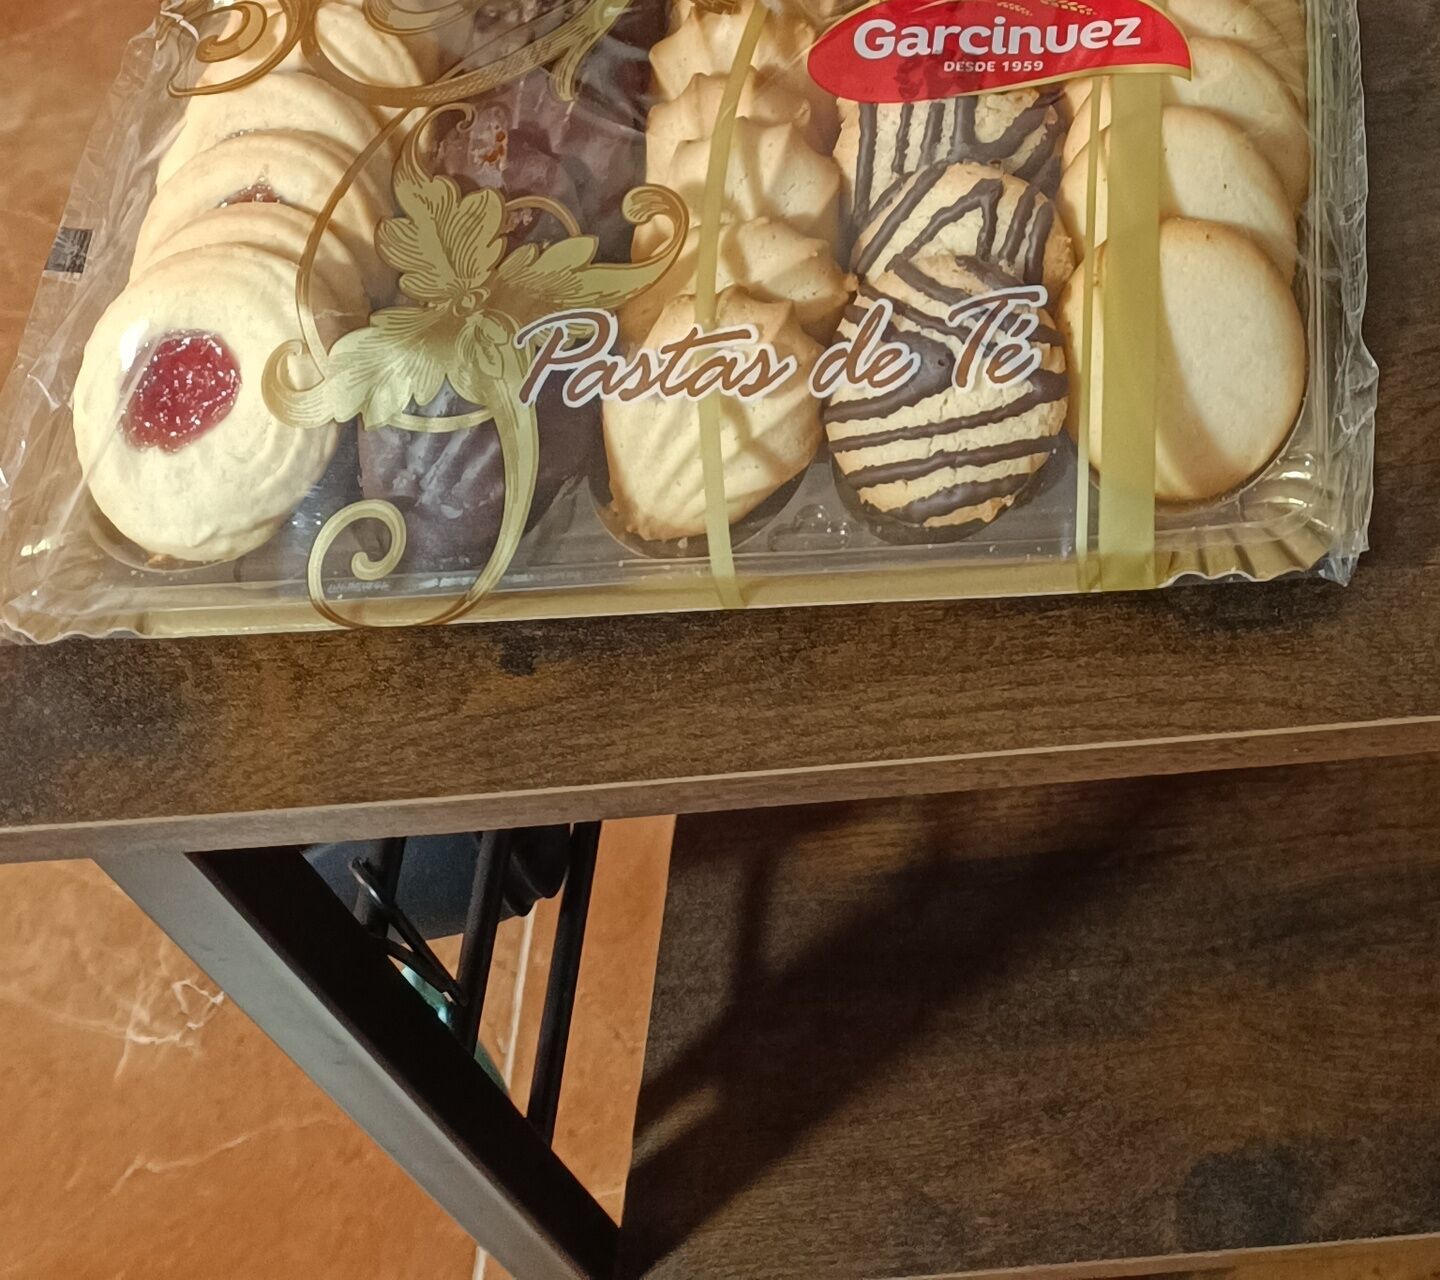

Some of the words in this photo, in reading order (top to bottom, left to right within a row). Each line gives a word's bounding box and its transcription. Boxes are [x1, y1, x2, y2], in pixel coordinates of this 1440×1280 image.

[854, 16, 1141, 60] Garcinuez
[943, 60, 996, 73] DESDE
[1002, 59, 1044, 72] 1959
[516, 308, 797, 408] Pastas
[809, 298, 921, 398] de
[947, 285, 1047, 394] Té
